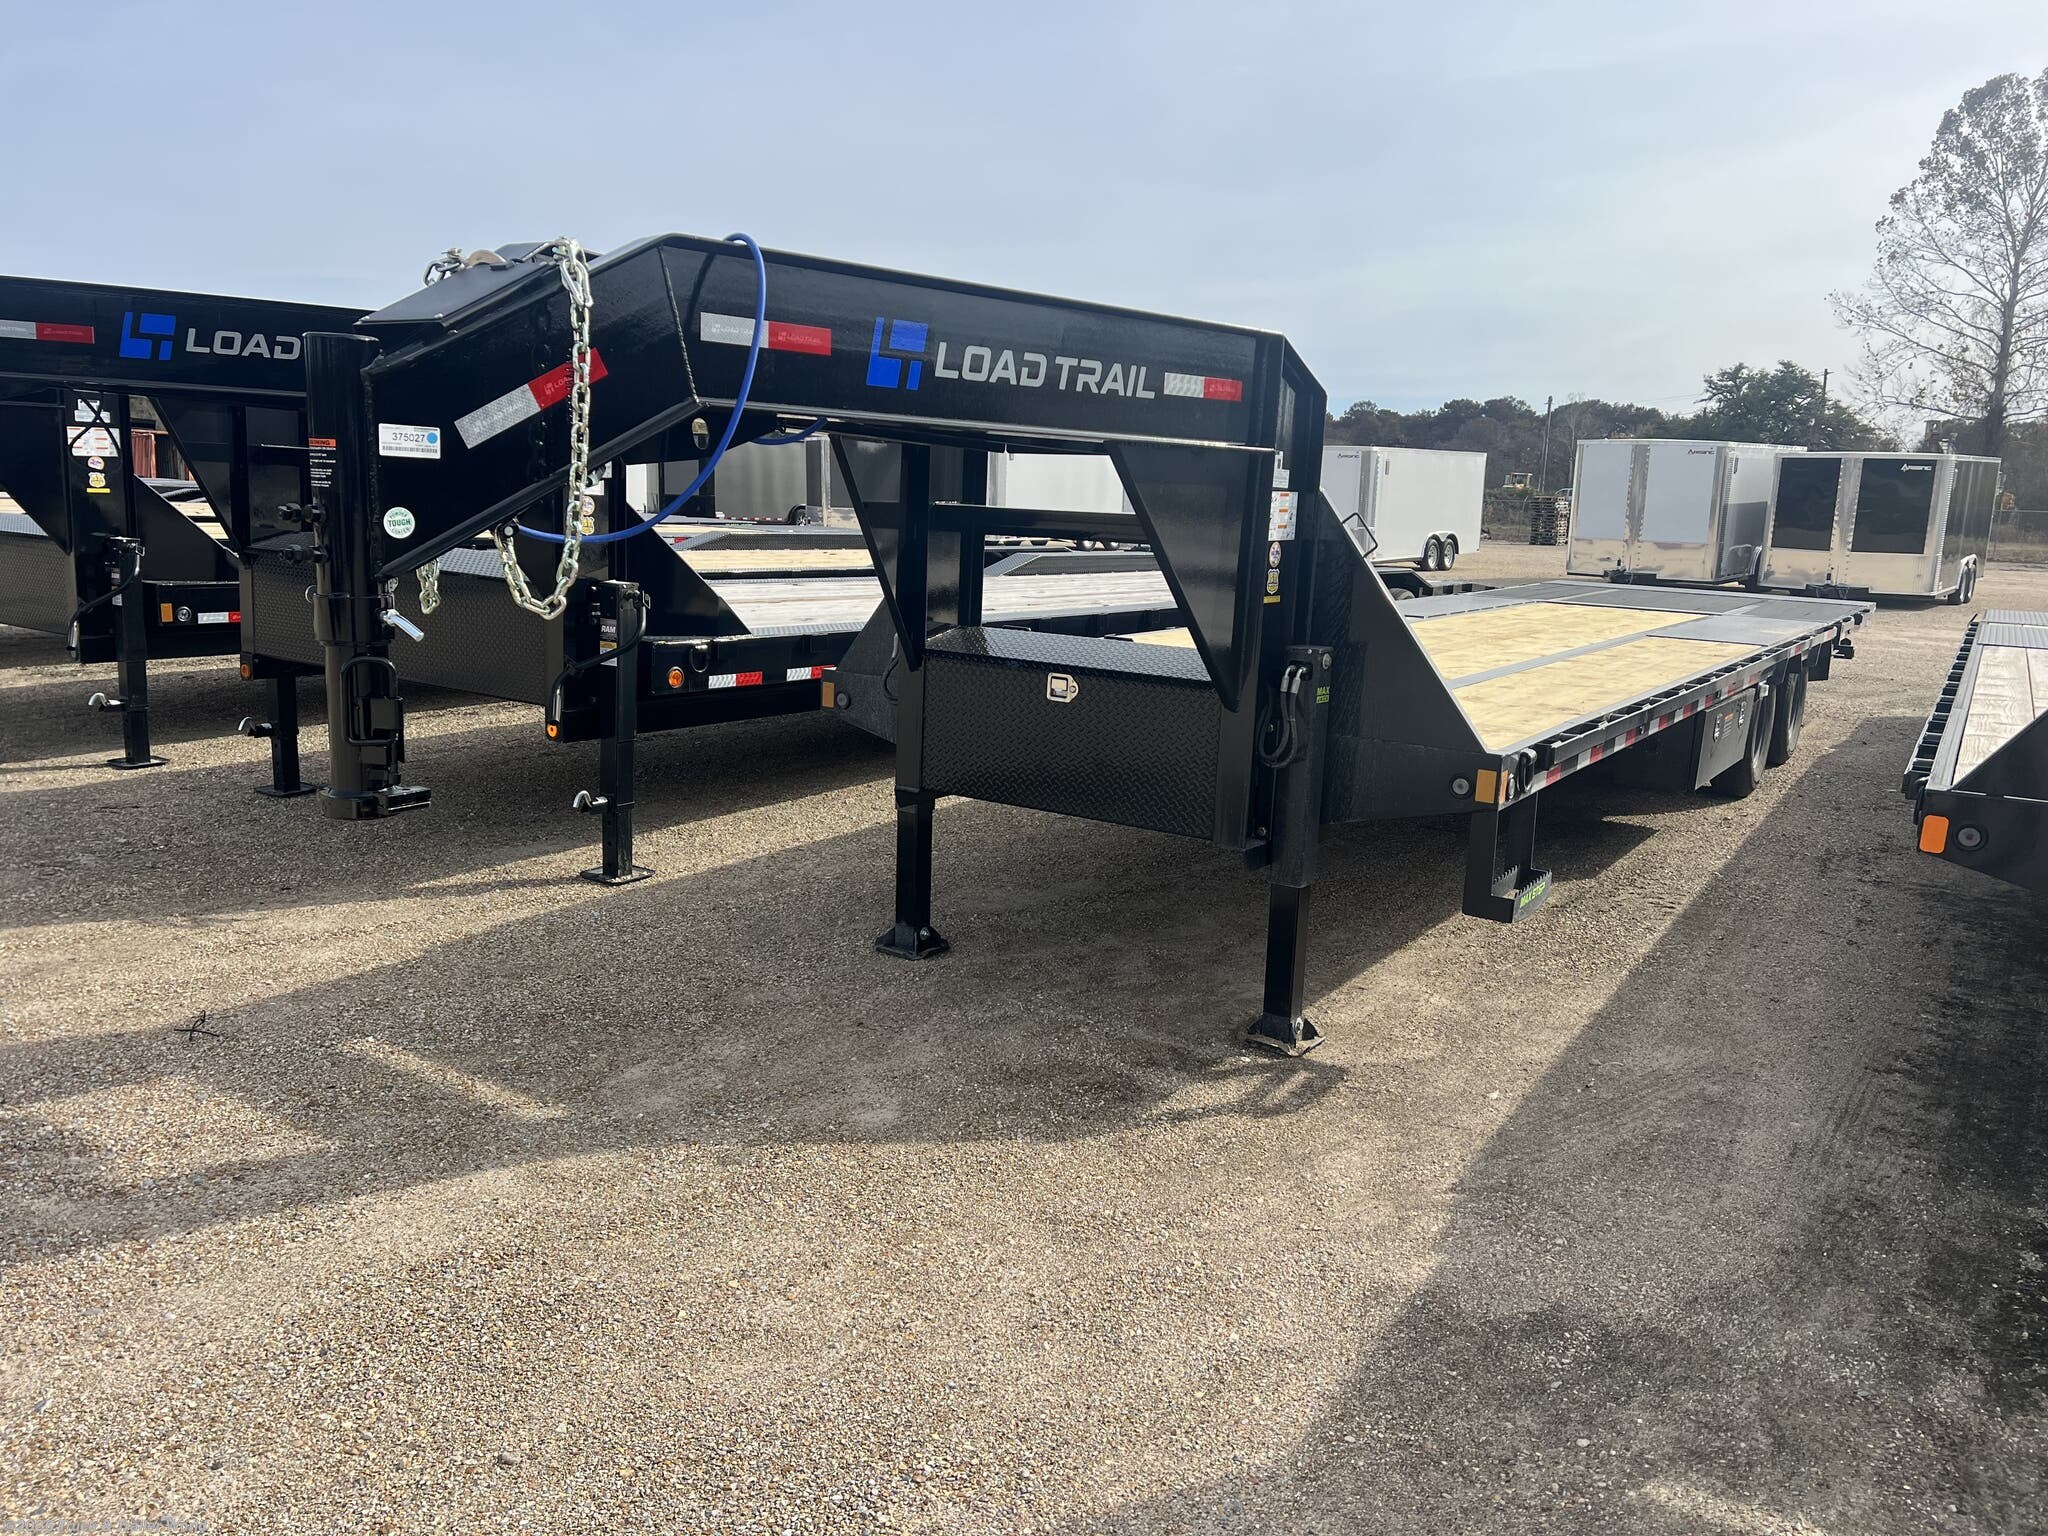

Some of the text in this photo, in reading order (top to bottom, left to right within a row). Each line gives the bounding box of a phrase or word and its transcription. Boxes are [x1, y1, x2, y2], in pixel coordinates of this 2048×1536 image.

[186, 327, 301, 361] LOAD
[934, 341, 1156, 400] LOAD TRAIL
[391, 432, 425, 443] 375027
[388, 519, 411, 528] TOUGH
